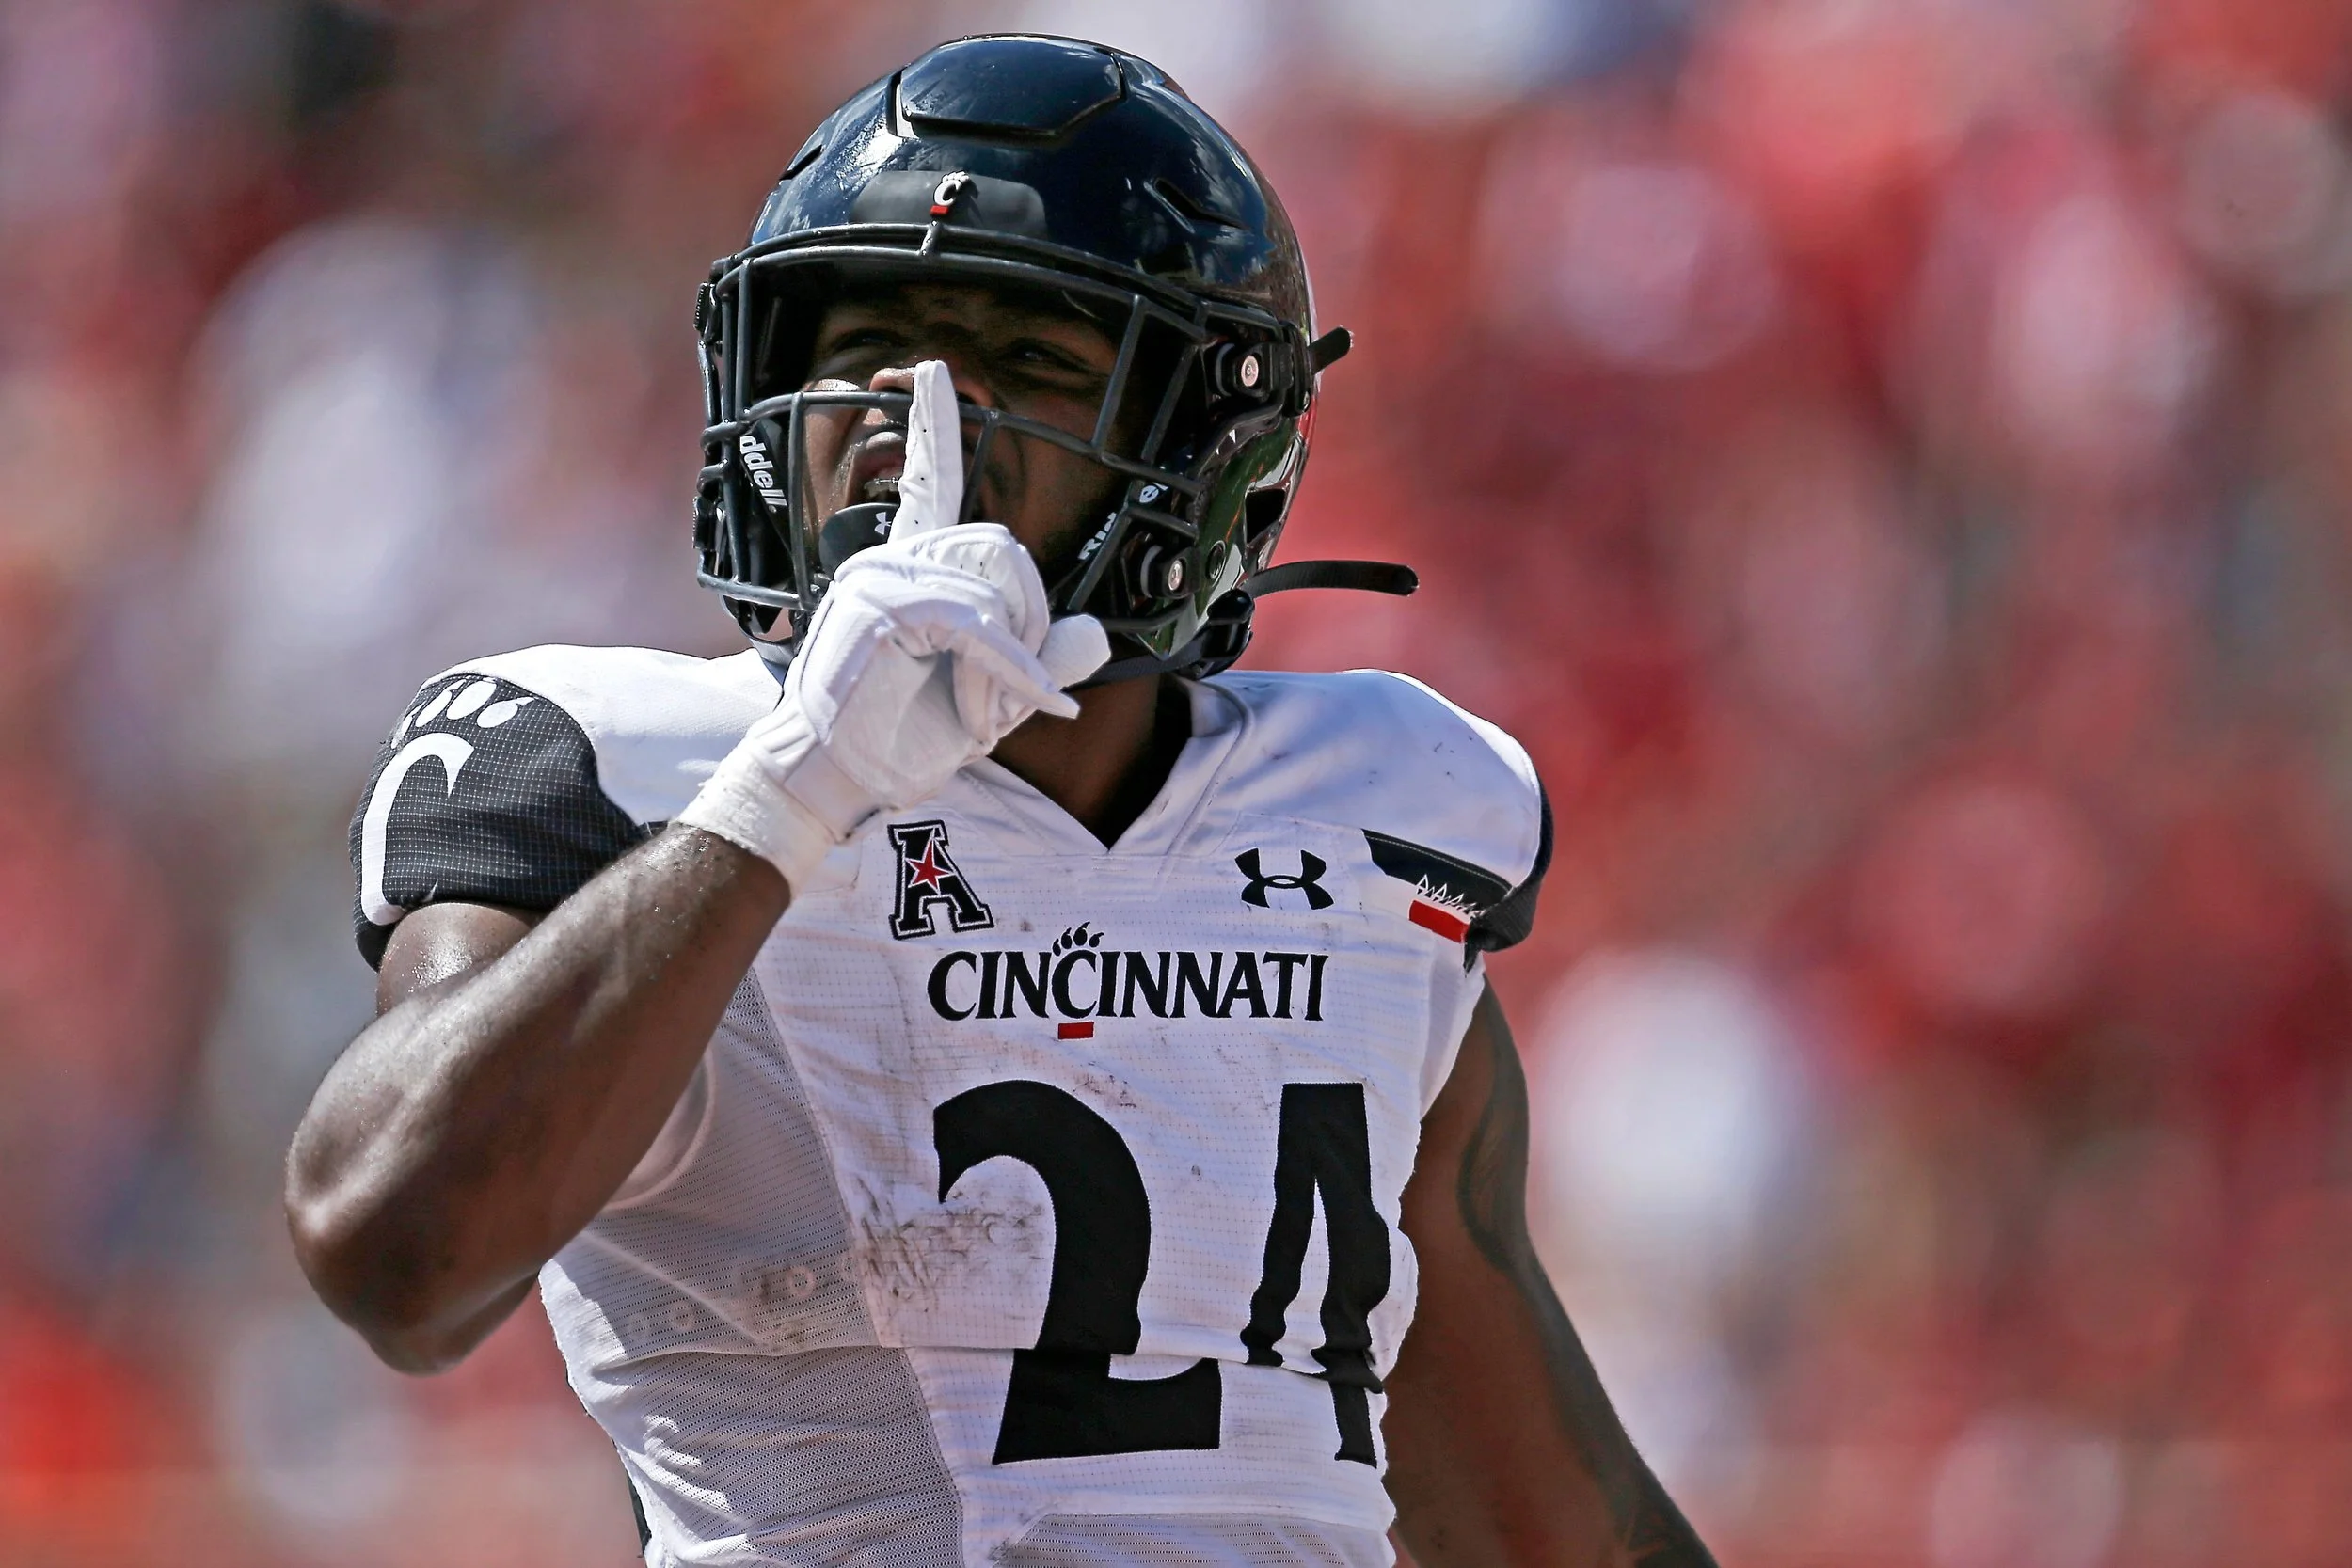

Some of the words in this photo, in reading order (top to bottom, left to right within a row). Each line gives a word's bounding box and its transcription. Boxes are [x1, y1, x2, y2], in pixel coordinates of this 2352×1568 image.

[887, 818, 995, 941] A
[927, 949, 1329, 1022] CINCINNATI
[933, 1079, 1391, 1468] 24
